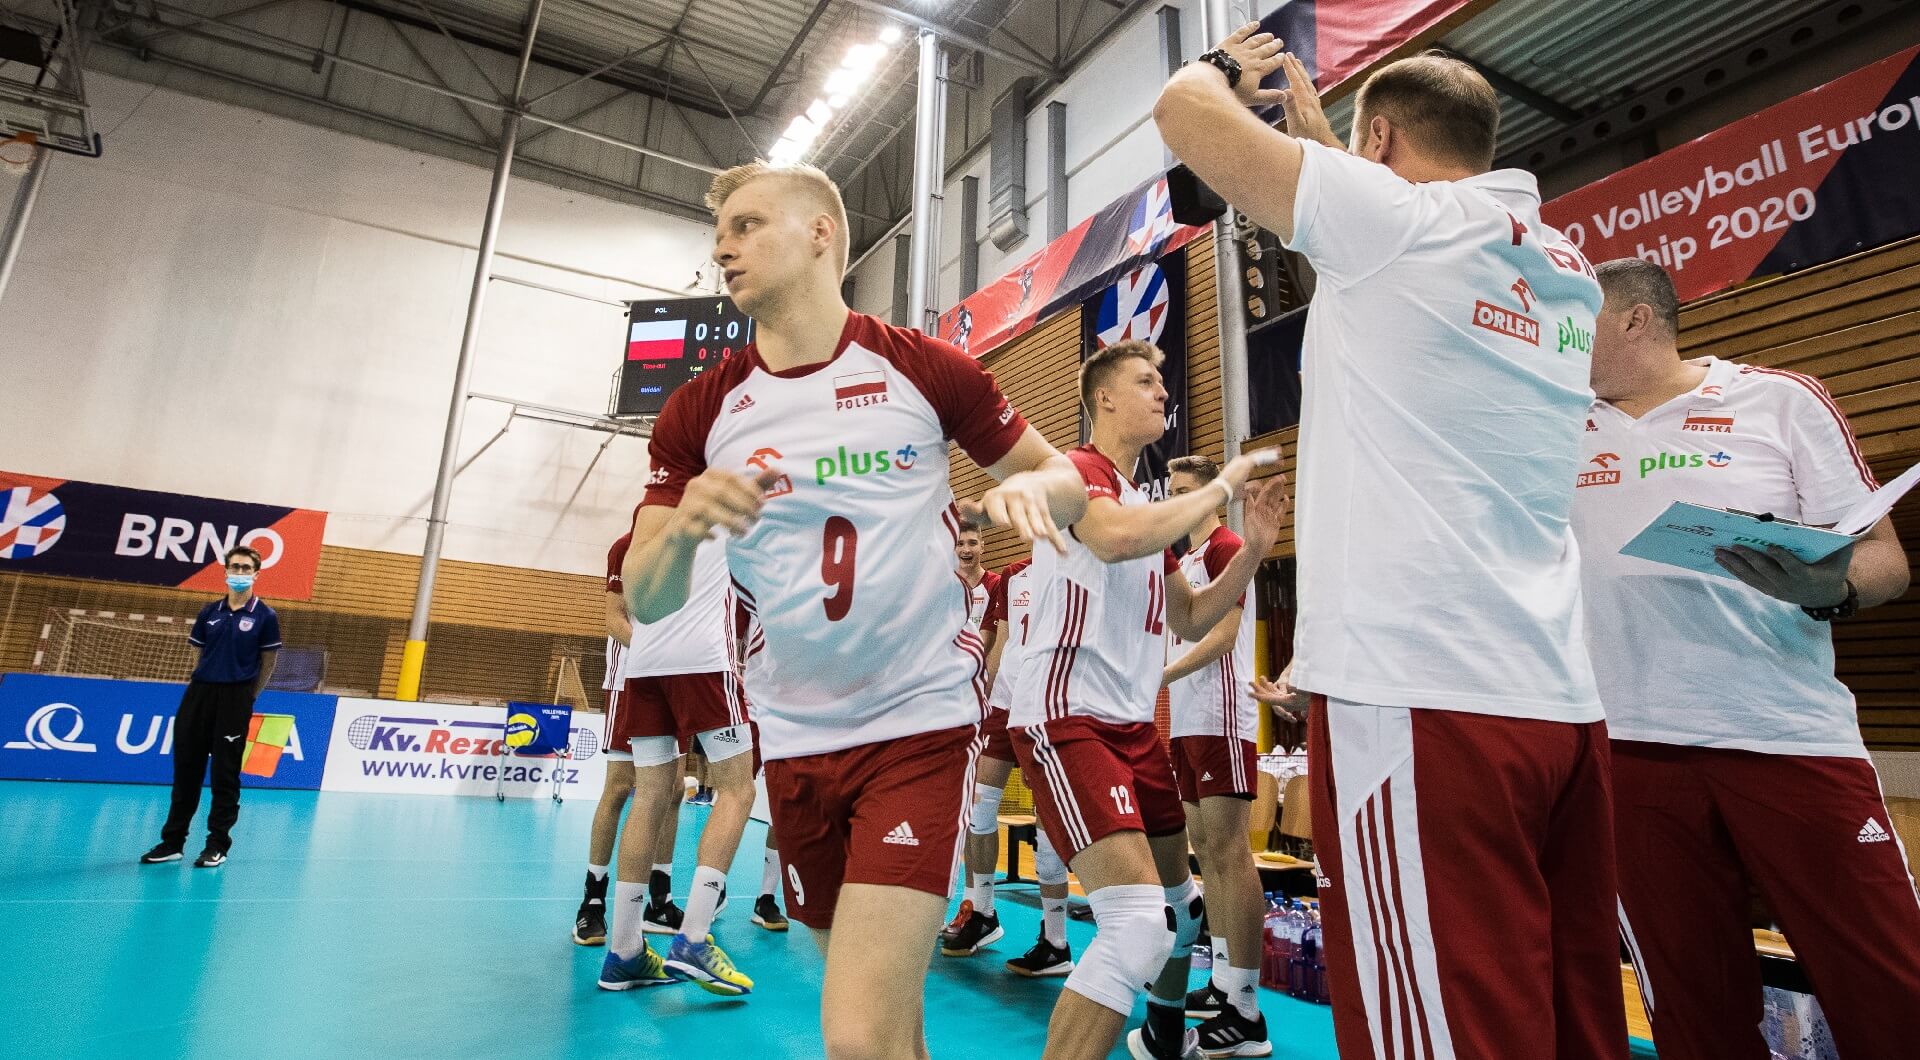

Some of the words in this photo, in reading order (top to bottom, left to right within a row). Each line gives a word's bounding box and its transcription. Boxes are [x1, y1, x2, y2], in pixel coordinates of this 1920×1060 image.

[1593, 139, 1788, 240] Volleyball
[1706, 187, 1817, 251] 2020
[654, 306, 668, 314] POL
[716, 301, 723, 315] 1
[1477, 306, 1537, 342] ORLEN
[836, 394, 889, 412] POLSKA
[1682, 424, 1732, 434] POLSKA
[814, 445, 891, 486] plus
[1639, 451, 1704, 479] plus
[1576, 472, 1617, 487] RLEN
[114, 512, 284, 570] BRNO
[821, 515, 858, 622] 9
[1144, 570, 1164, 636] 12
[713, 735, 740, 744] adidas
[361, 758, 579, 784] www.kvrezac.cz
[1109, 785, 1135, 815] 12
[882, 835, 920, 847] adidas
[1857, 833, 1890, 843] adidas
[787, 863, 805, 906] 9
